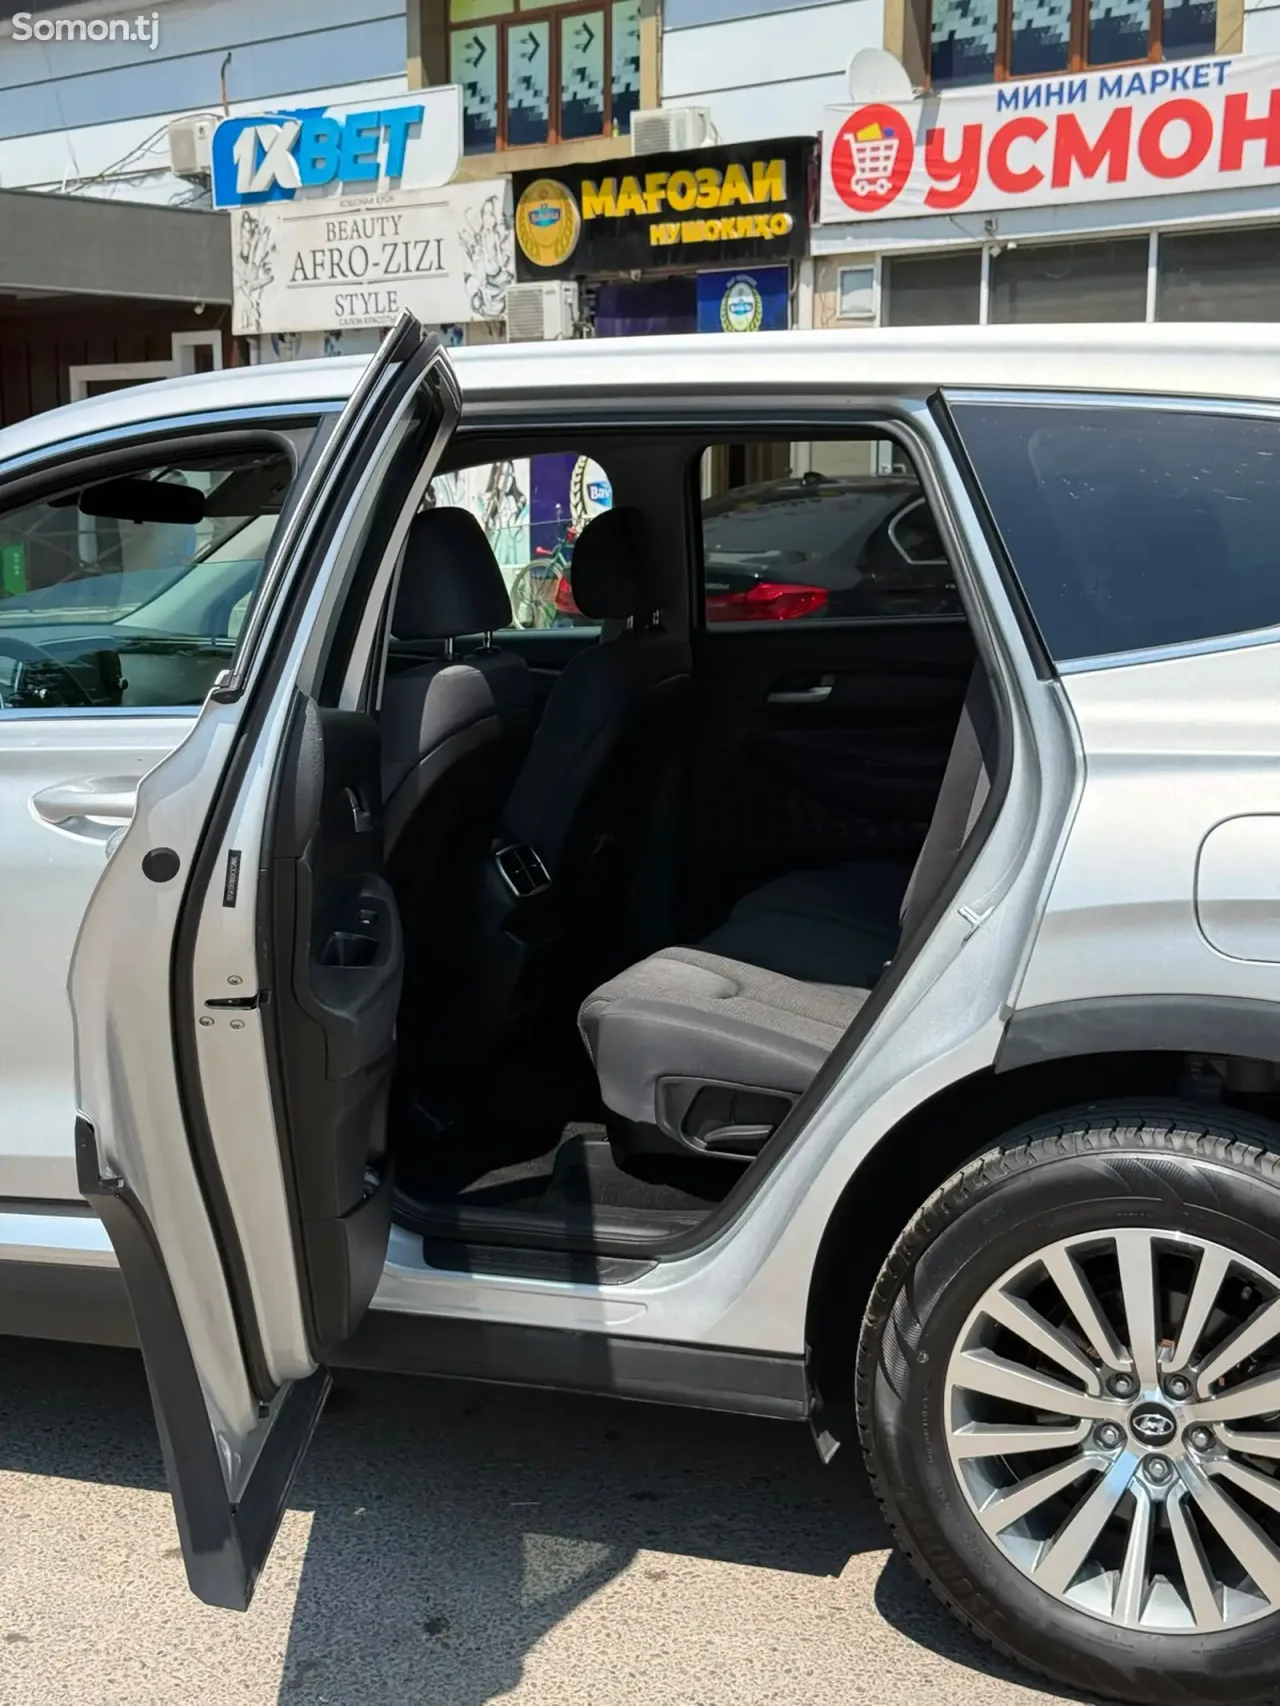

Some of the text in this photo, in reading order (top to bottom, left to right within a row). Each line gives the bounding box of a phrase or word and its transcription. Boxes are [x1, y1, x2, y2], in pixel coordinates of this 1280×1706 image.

[996, 60, 1233, 113] МИНИ МАРКЕТ
[325, 214, 402, 243] BEAUTY
[289, 237, 446, 283] AFRO-ZIZI
[334, 290, 399, 318] STYLE
